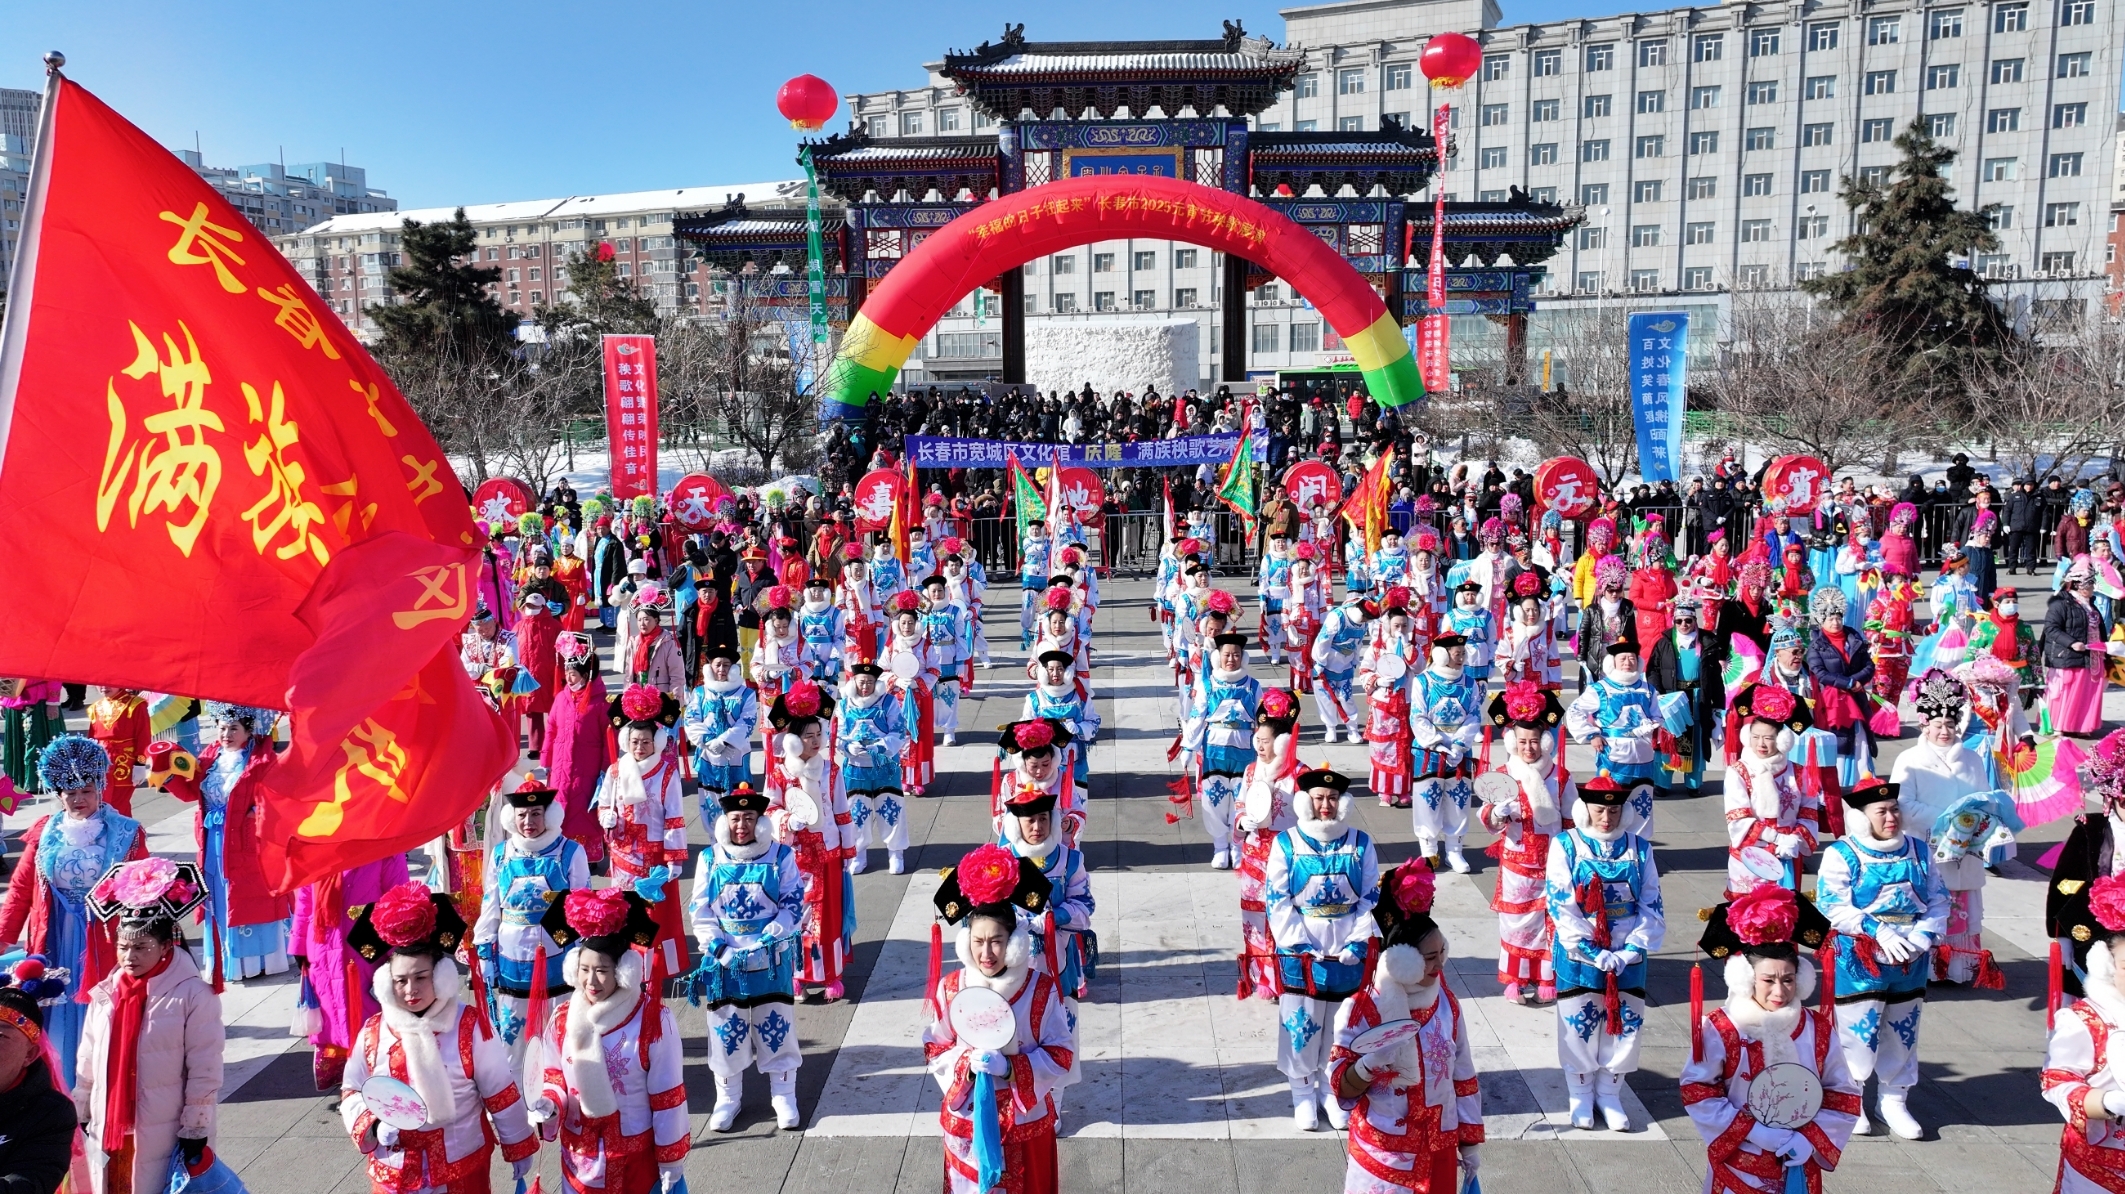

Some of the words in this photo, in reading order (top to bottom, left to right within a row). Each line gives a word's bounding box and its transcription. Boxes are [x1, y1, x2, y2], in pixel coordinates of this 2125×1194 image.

[618, 363, 638, 475] 秧歌翩翩传佳音
[482, 491, 516, 522] 欢
[687, 489, 714, 521] 天
[867, 481, 895, 519] 喜
[1062, 480, 1094, 512] 地
[1298, 474, 1327, 513] 闹
[1554, 474, 1587, 511] 元
[1788, 469, 1818, 508] 宵
